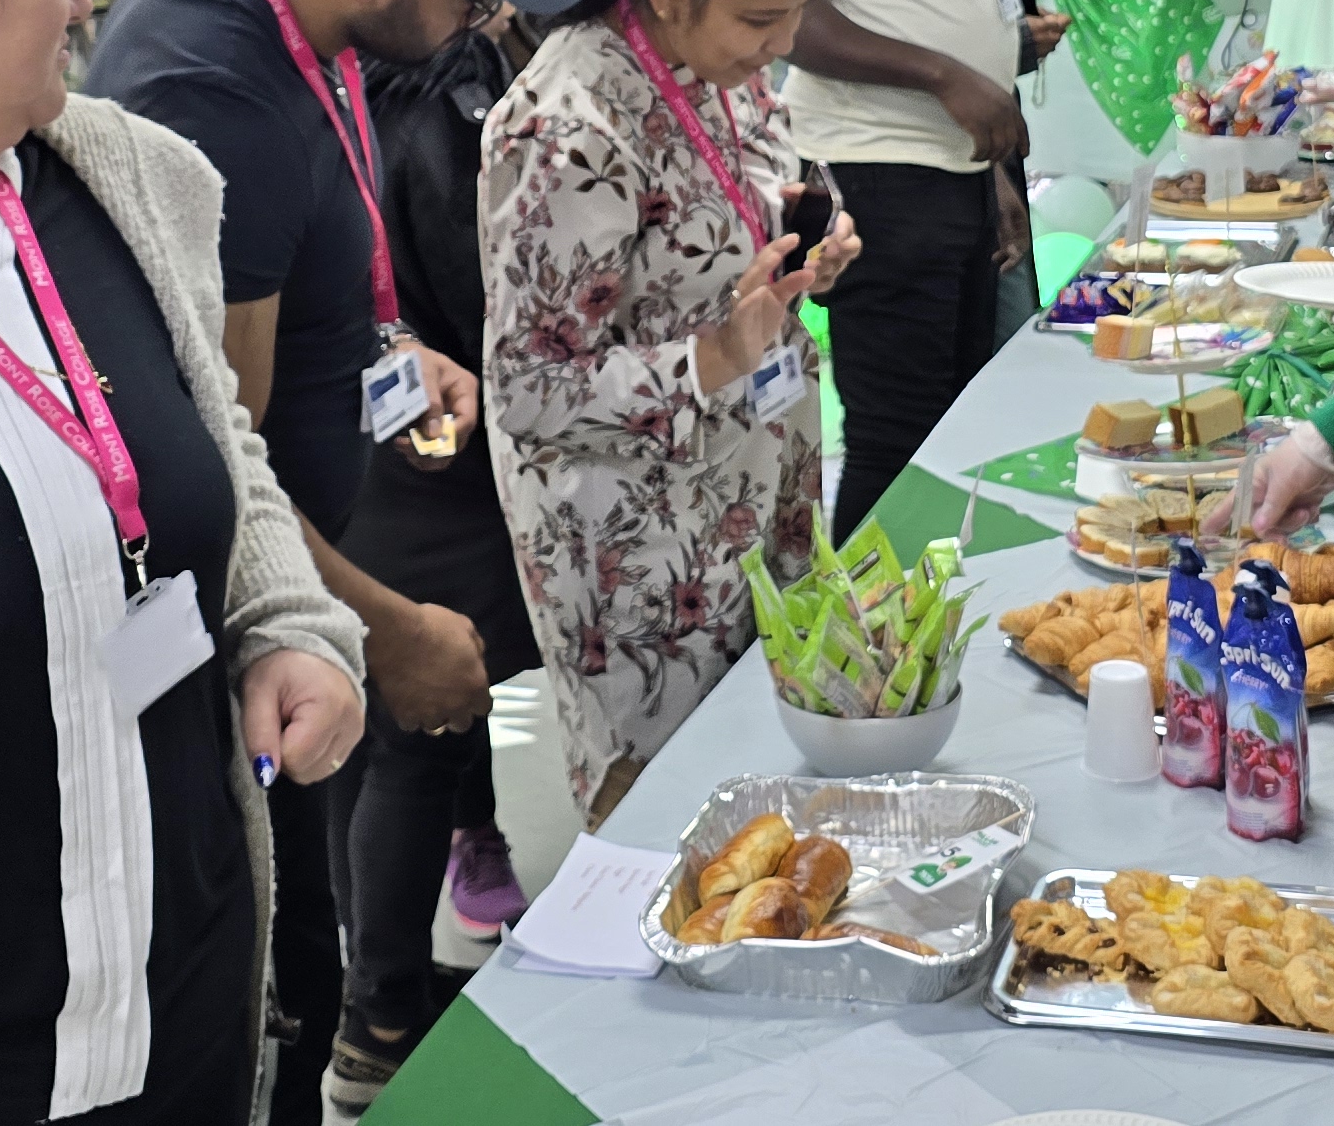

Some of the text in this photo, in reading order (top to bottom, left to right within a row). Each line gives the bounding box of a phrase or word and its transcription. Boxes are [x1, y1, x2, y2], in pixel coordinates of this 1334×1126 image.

[27, 383, 65, 423] ROSE
[84, 389, 109, 429] ROSE
[102, 433, 130, 483] MONT
